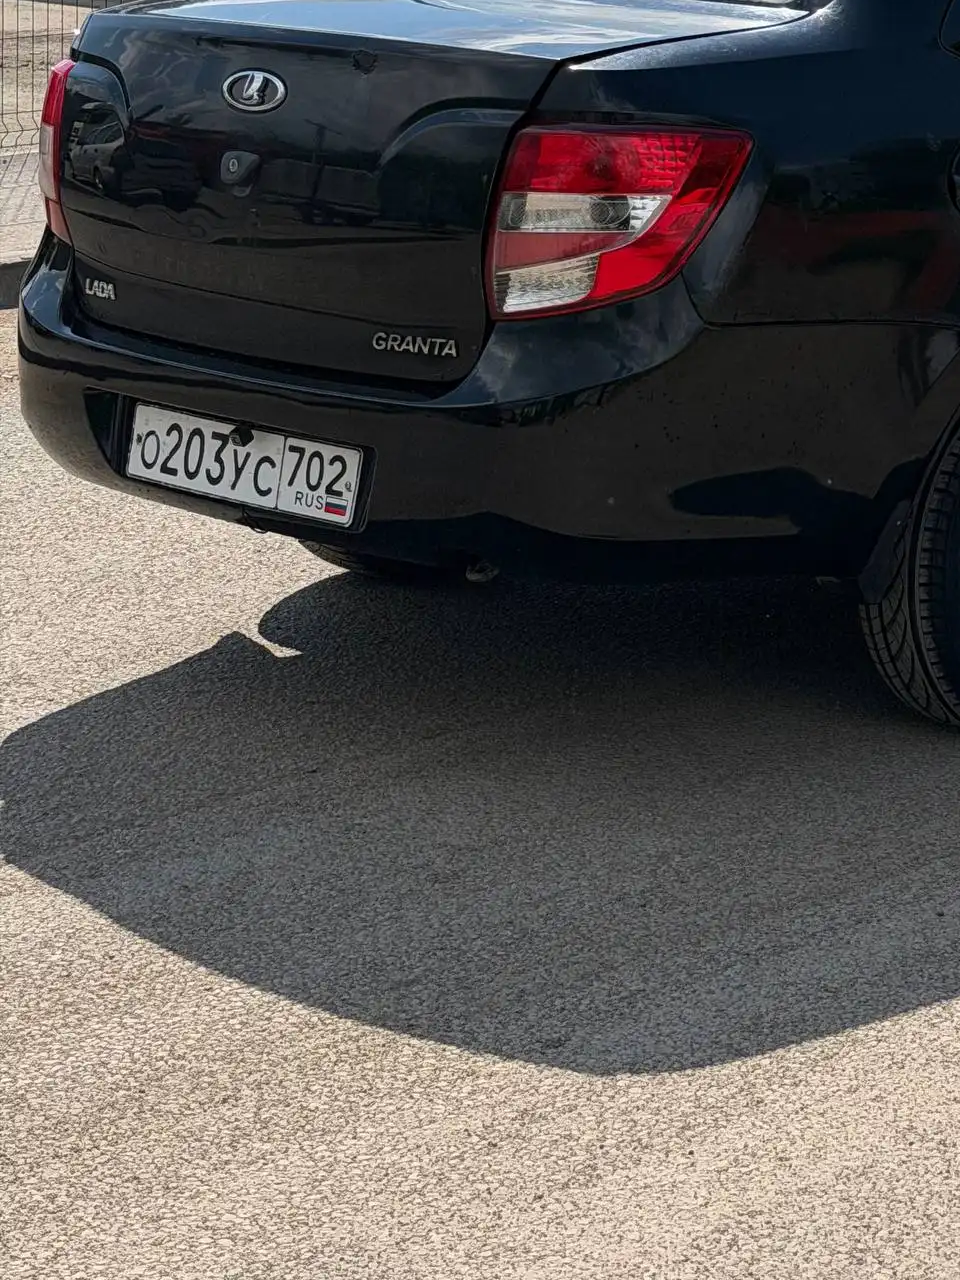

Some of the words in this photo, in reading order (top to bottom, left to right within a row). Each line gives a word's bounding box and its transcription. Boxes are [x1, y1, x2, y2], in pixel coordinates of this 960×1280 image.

[84, 277, 117, 301] LADA
[371, 331, 458, 358] GRANTA
[287, 444, 348, 498] 702
[294, 490, 324, 511] RUS
